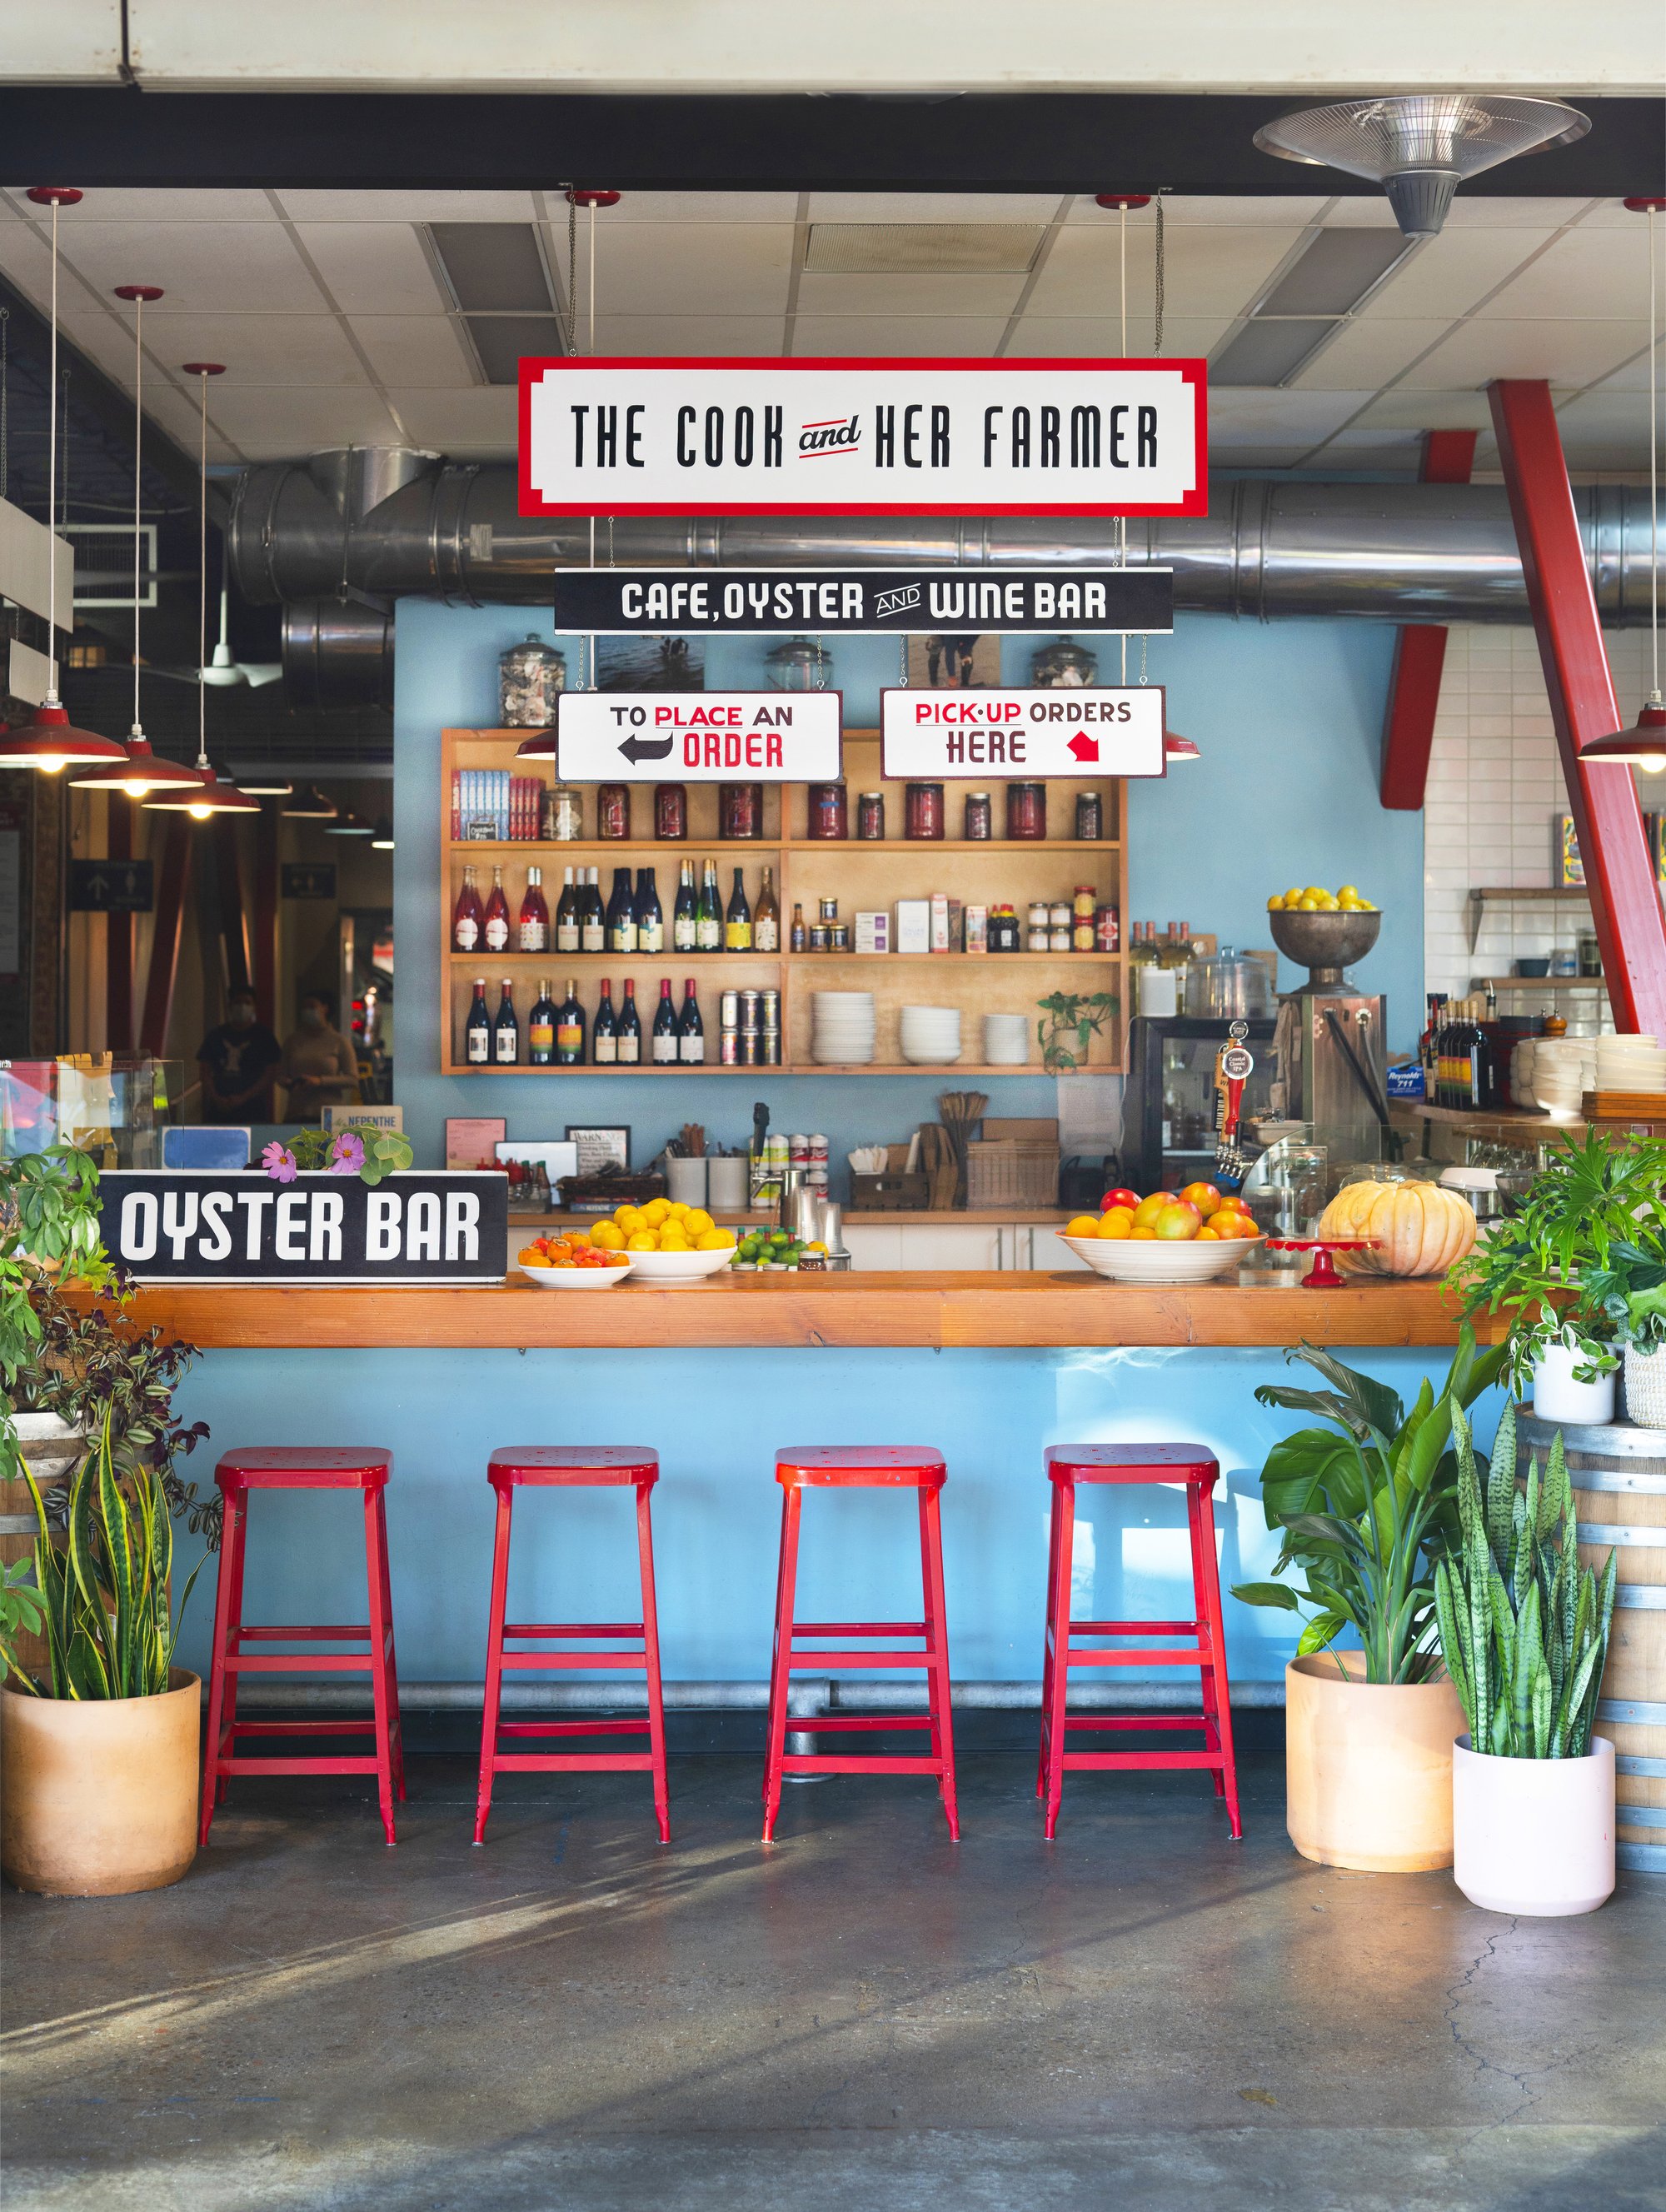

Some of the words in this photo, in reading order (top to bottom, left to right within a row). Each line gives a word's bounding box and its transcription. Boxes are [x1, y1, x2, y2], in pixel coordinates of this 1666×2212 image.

[571, 405, 645, 468] THE
[676, 405, 783, 468] COOK
[799, 414, 862, 451] and
[875, 404, 950, 468] HER
[984, 406, 1158, 468] FARMER
[876, 587, 920, 614] AND
[930, 582, 1024, 619] WINE
[1034, 582, 1106, 619] BAR
[611, 707, 646, 727] TO
[656, 707, 743, 727] PLACE
[752, 707, 793, 727] AN
[1030, 702, 1131, 723] ORDERS
[683, 733, 784, 767] ORDER
[946, 730, 1027, 763] HERE
[120, 1191, 344, 1261] OYSTER
[365, 1191, 480, 1261] BAR
